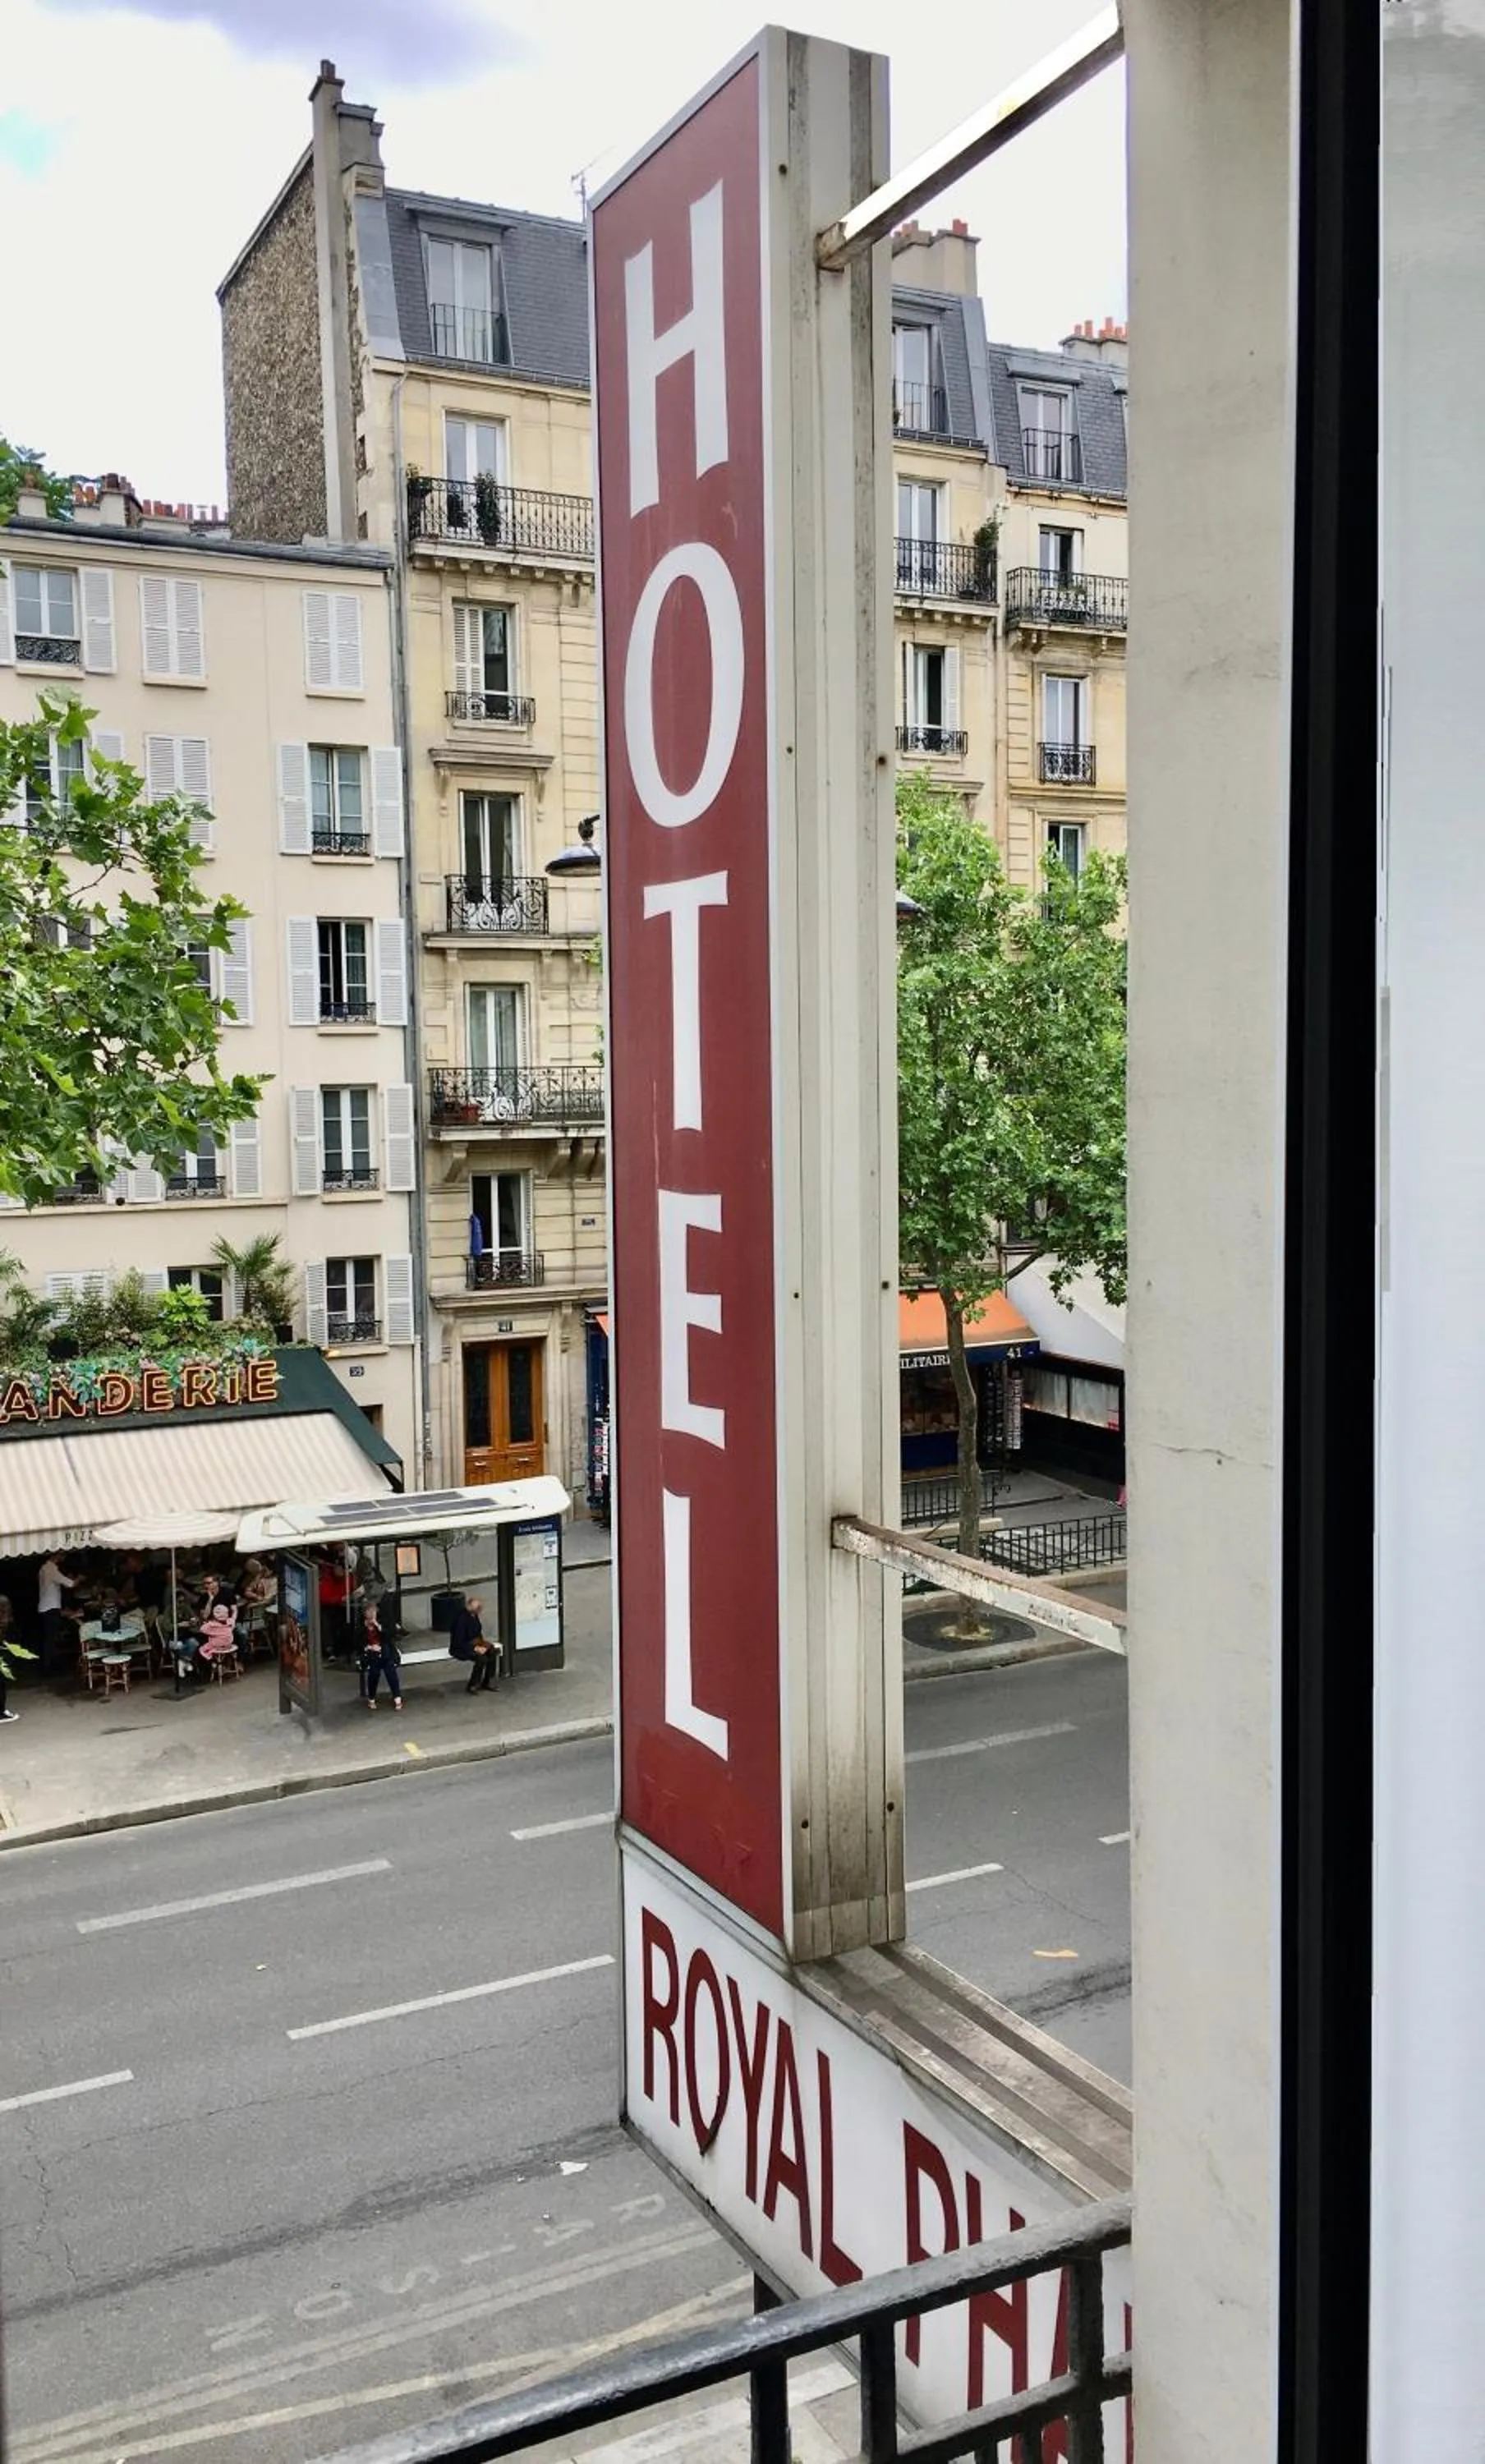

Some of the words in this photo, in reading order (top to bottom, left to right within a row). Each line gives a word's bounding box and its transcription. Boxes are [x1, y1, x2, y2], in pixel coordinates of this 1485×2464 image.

[624, 178, 745, 1761] HOTEL
[901, 1354, 950, 1369] ILITAIR
[1006, 1347, 1022, 1358] 41
[0, 1361, 277, 1423] ANDERIE
[641, 1905, 863, 2286] ROYAL
